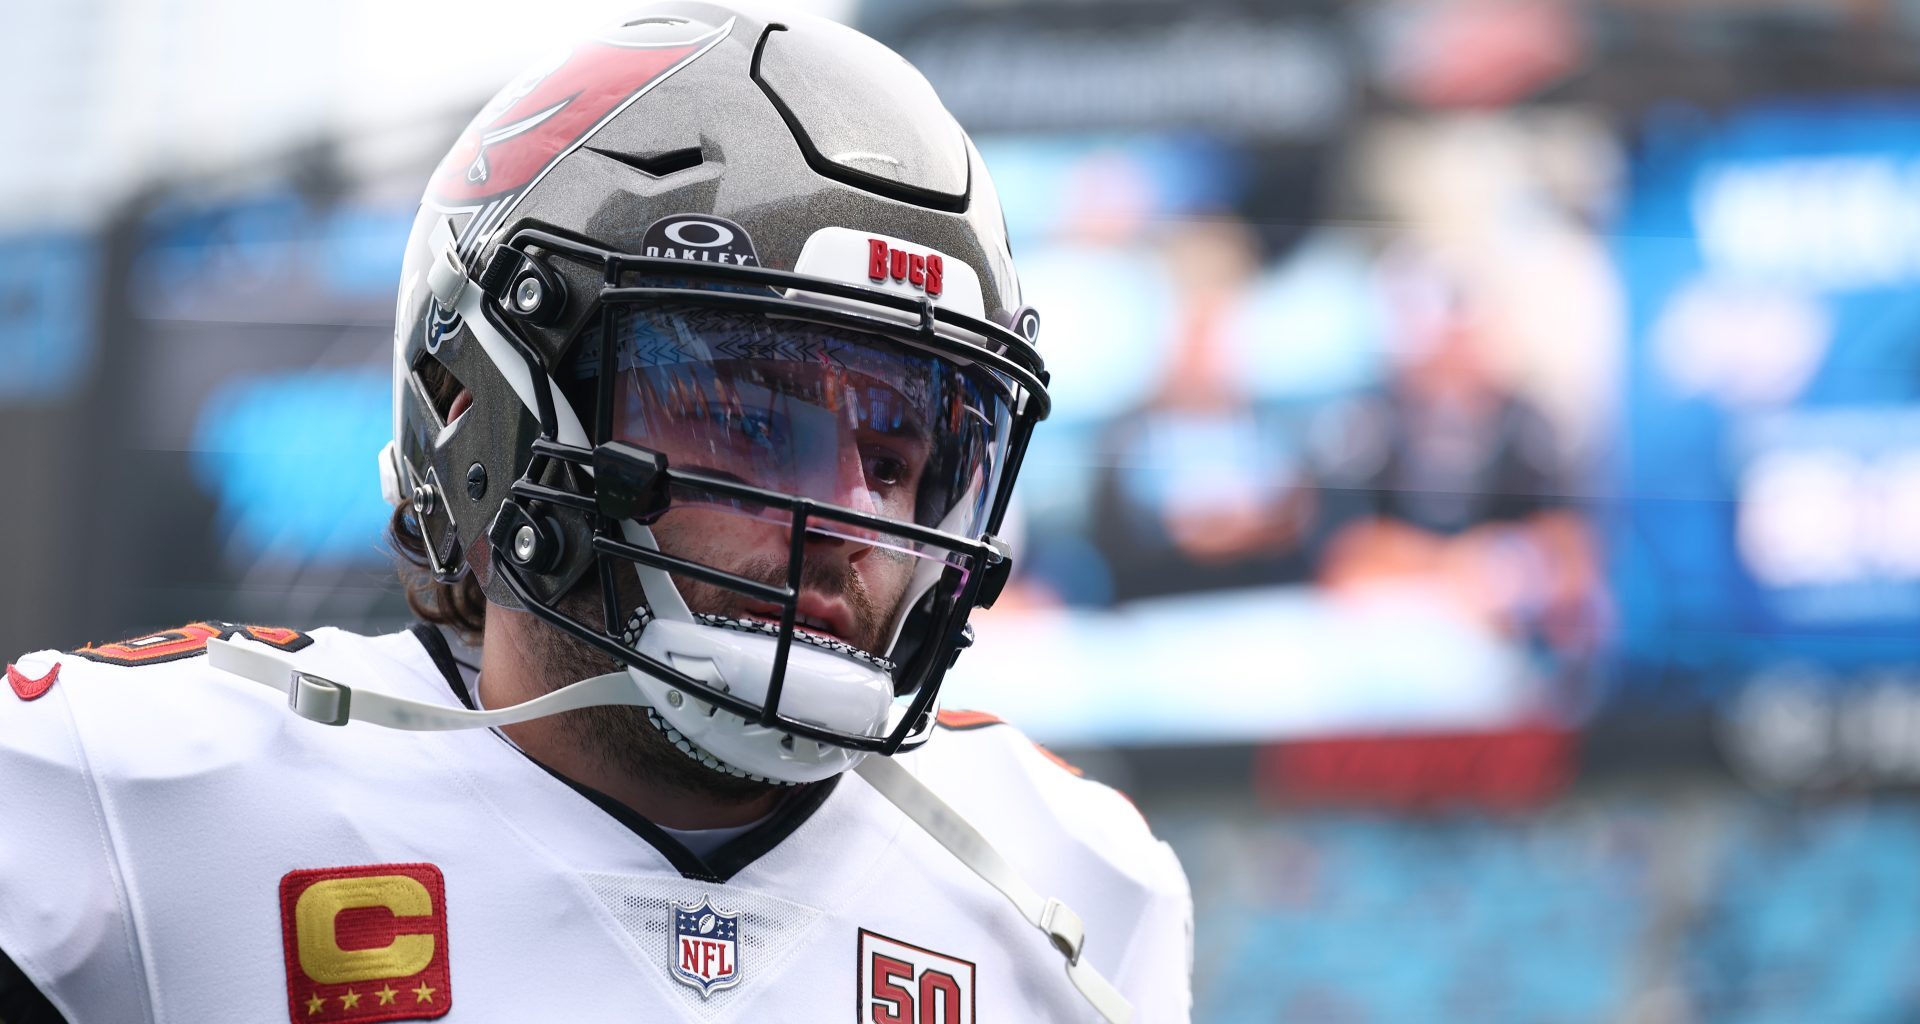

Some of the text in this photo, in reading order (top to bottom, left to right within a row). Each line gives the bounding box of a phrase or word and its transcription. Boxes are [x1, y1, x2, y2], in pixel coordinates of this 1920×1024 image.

[646, 246, 749, 266] OAKLEY
[295, 875, 435, 985] C
[681, 938, 734, 979] NFL
[872, 951, 961, 1024] 50
